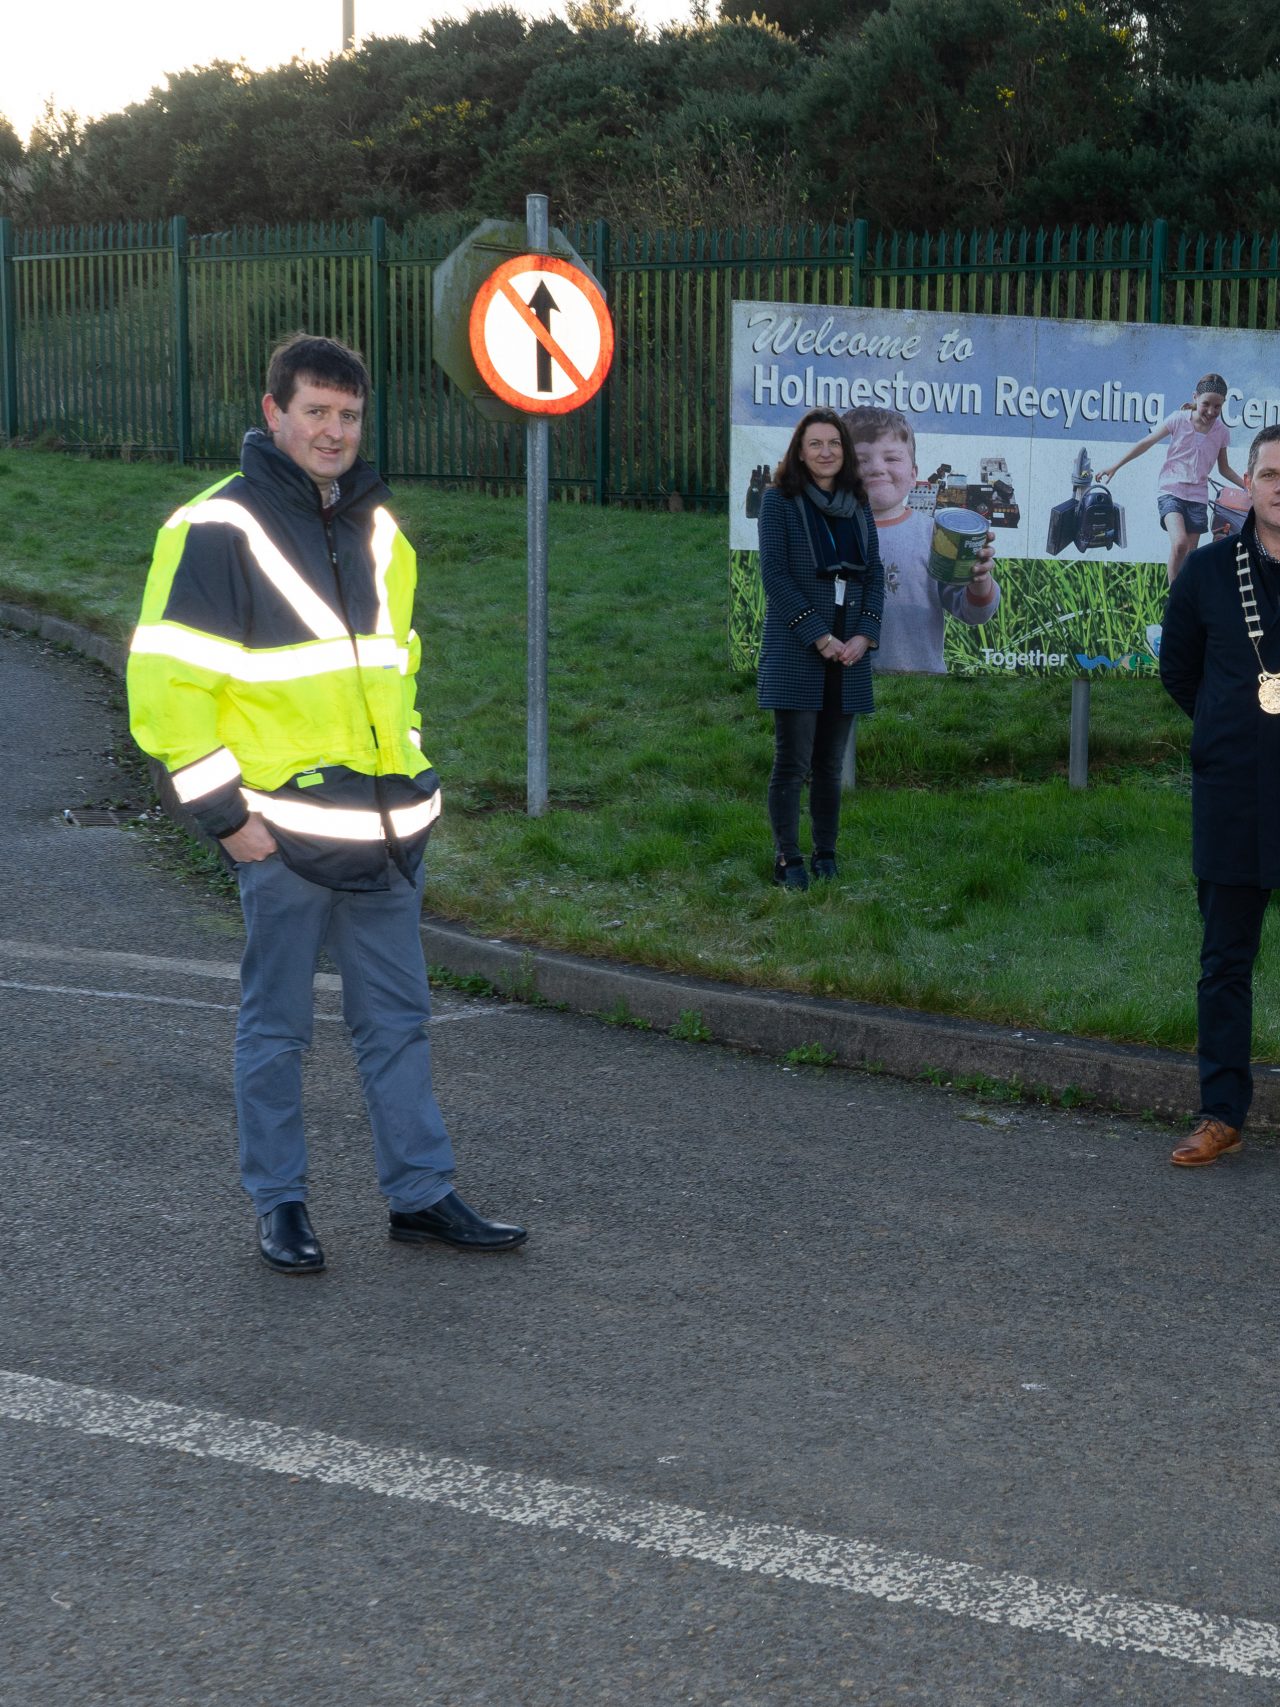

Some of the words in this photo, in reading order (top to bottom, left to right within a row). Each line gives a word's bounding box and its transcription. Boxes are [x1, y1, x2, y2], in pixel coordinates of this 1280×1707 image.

[748, 310, 921, 359] Welcome
[938, 328, 975, 362] to
[754, 364, 982, 415] Holmestown
[995, 376, 1166, 433] Recycling
[982, 648, 1068, 670] Together
